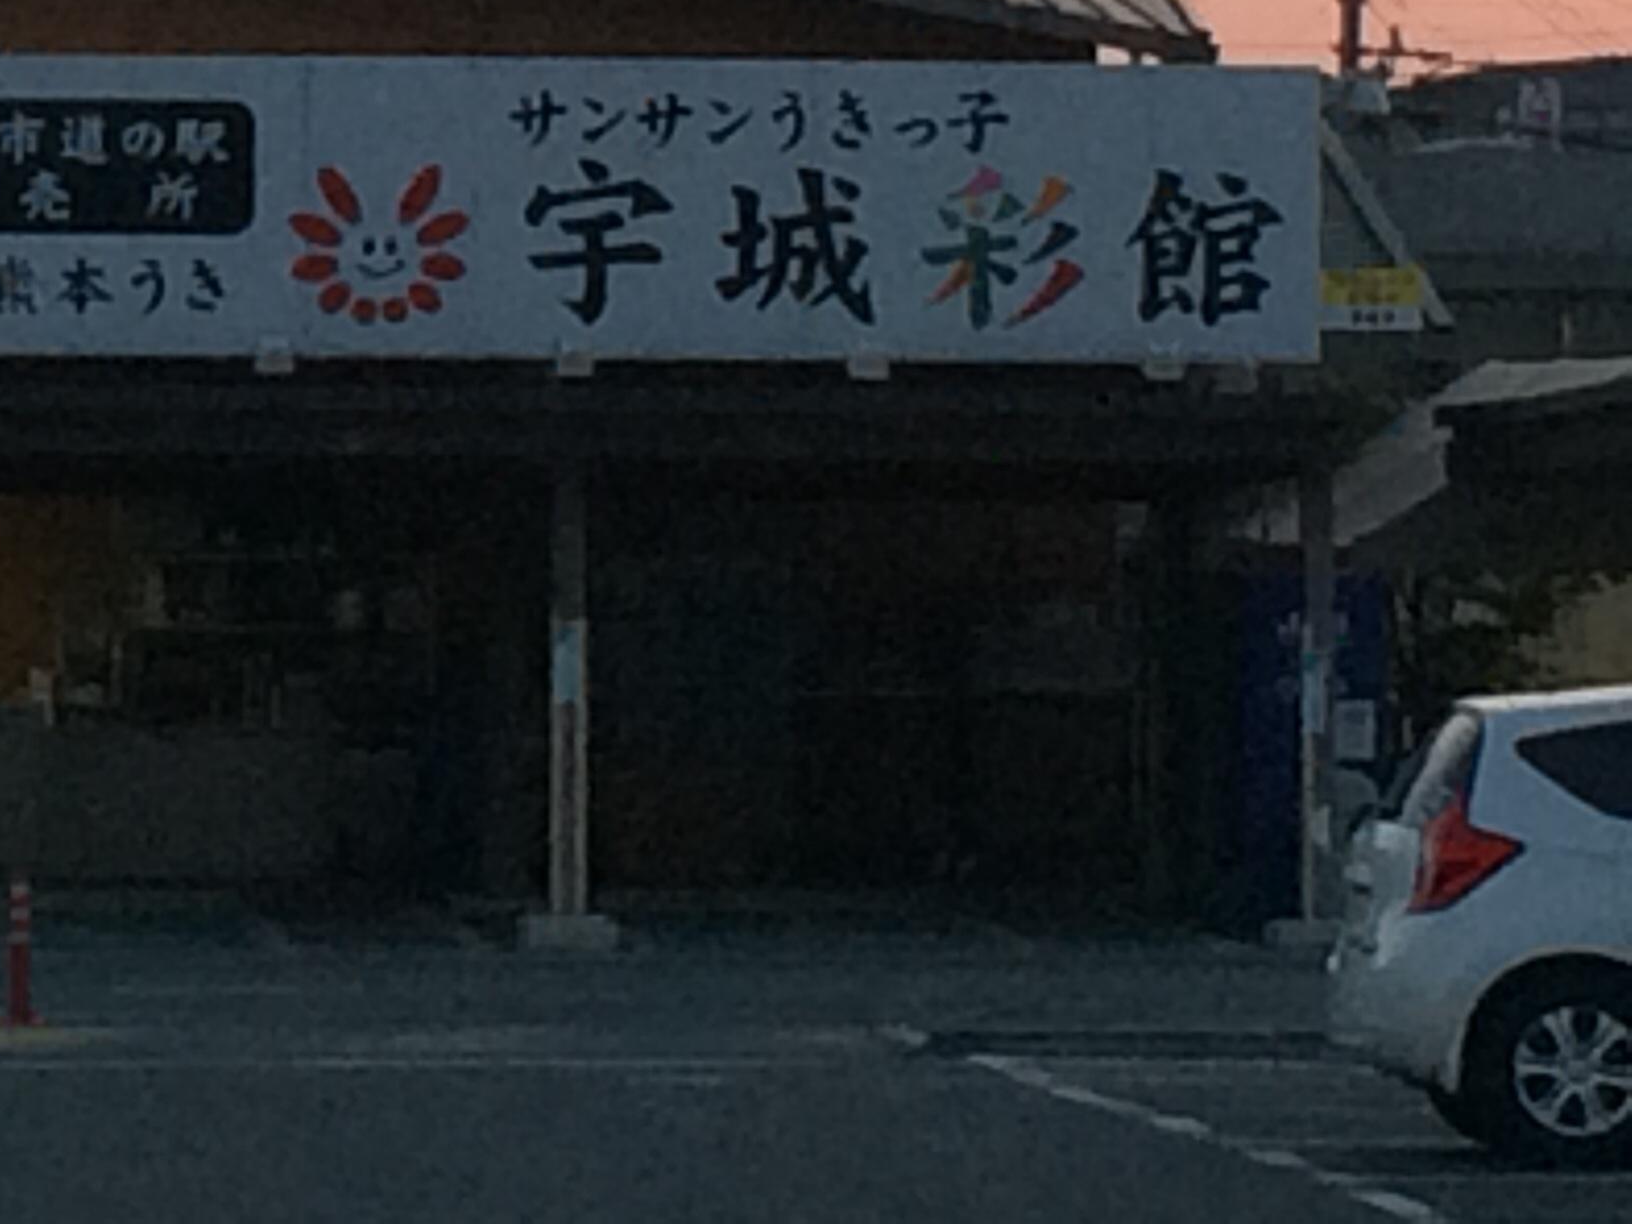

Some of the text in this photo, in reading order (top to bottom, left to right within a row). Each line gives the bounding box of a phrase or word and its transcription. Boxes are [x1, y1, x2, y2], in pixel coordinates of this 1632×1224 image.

[508, 89, 1011, 154] サンサンうきっ子
[522, 158, 1285, 328] 宇城彩館
